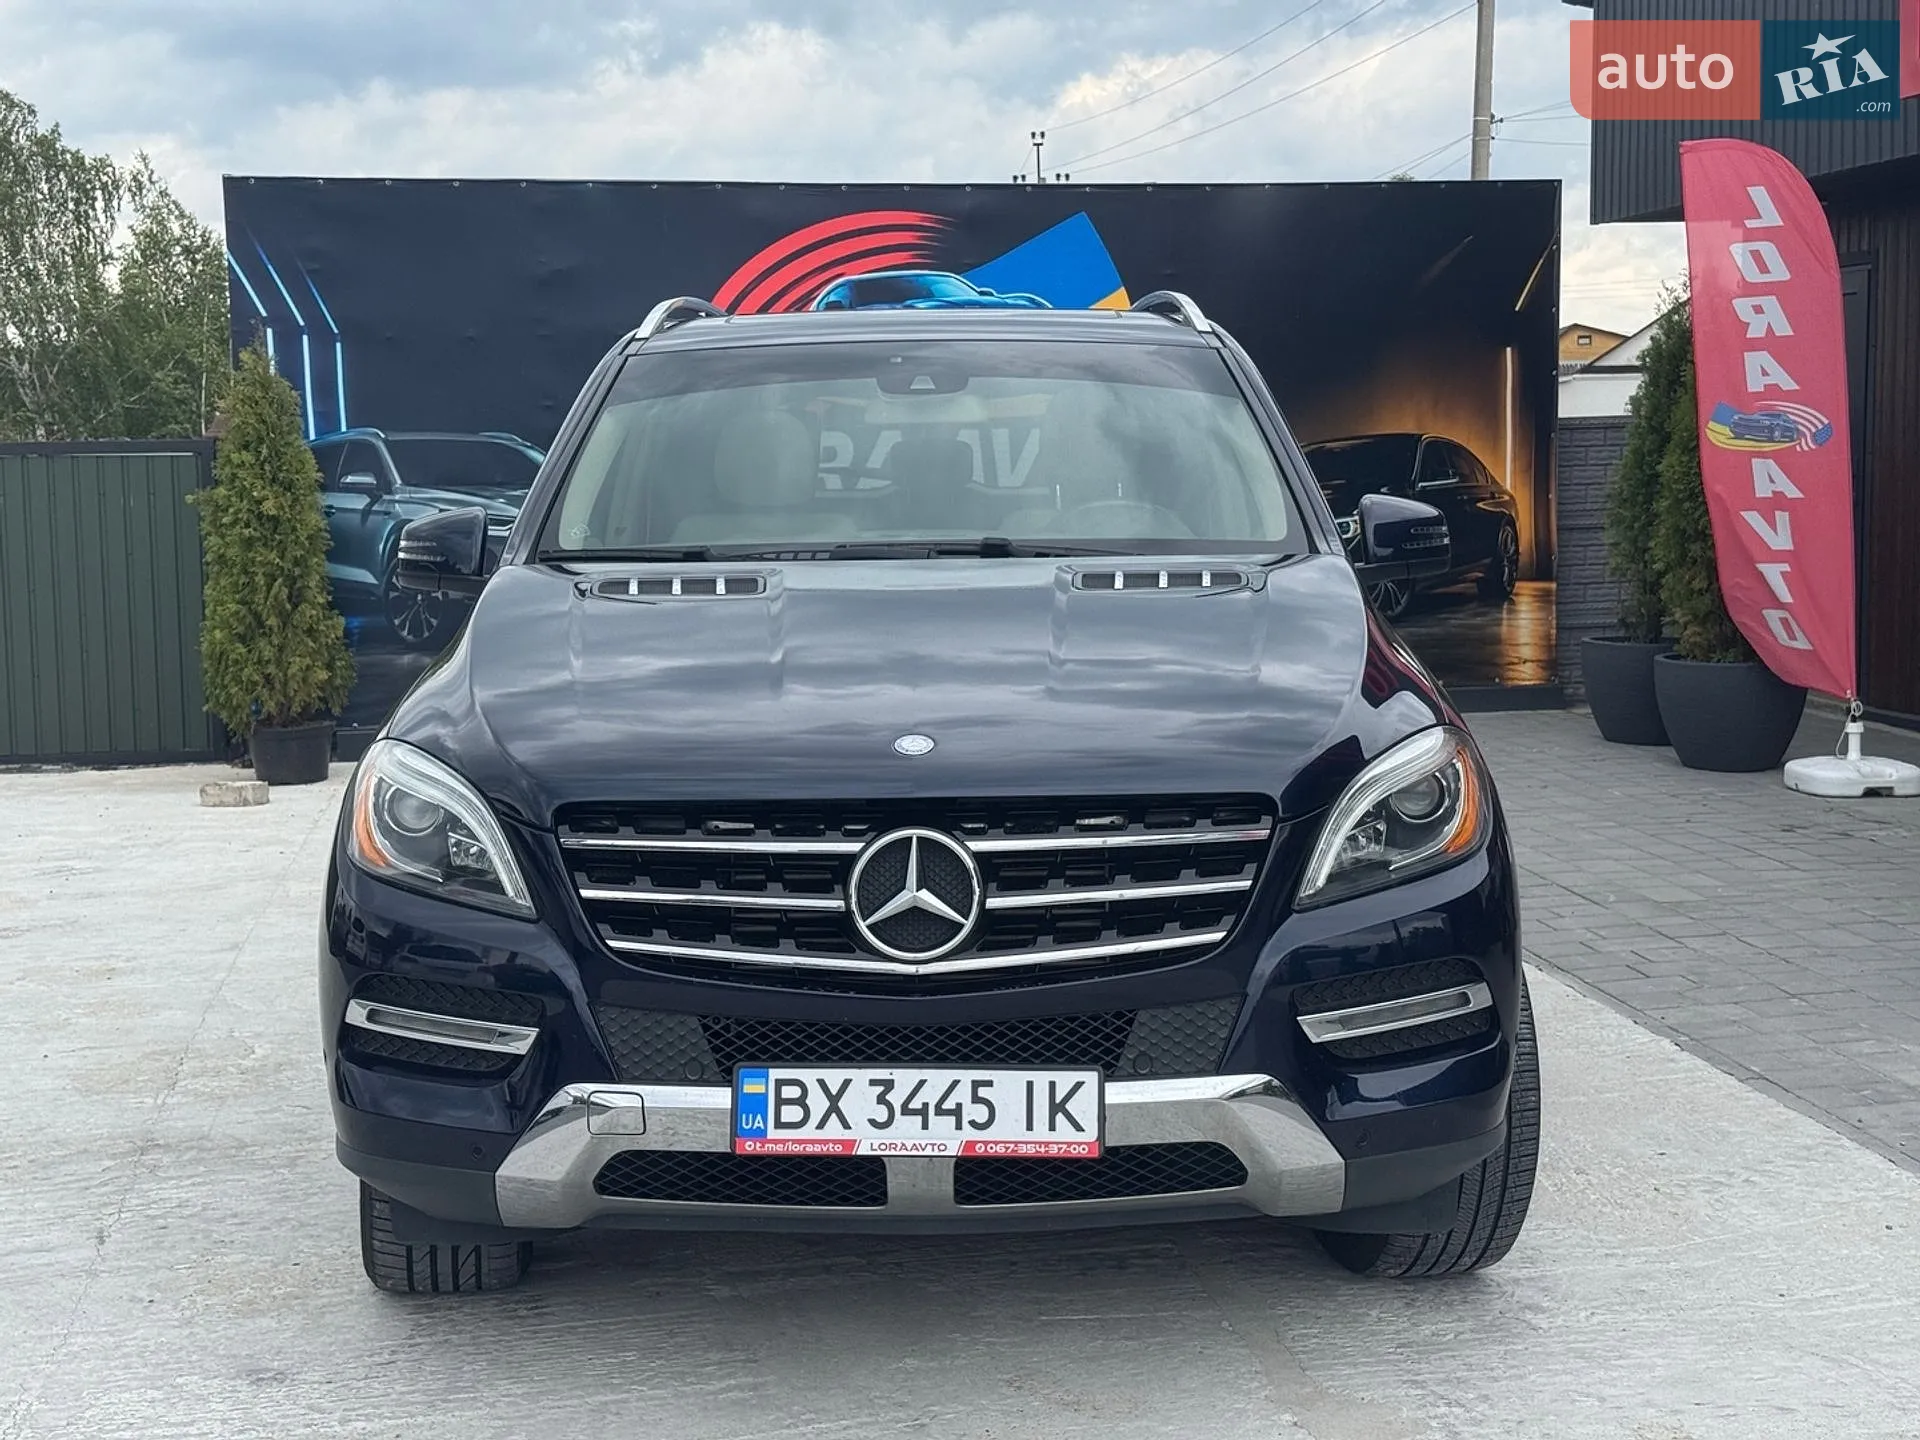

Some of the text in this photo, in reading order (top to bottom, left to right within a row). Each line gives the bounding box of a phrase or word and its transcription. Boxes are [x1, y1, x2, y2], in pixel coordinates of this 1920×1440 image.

[773, 1077, 1086, 1133] BX 3445 IK
[741, 1114, 765, 1130] UA
[755, 1140, 843, 1152] t.me/loraavto
[869, 1141, 948, 1153] LORAAVTO
